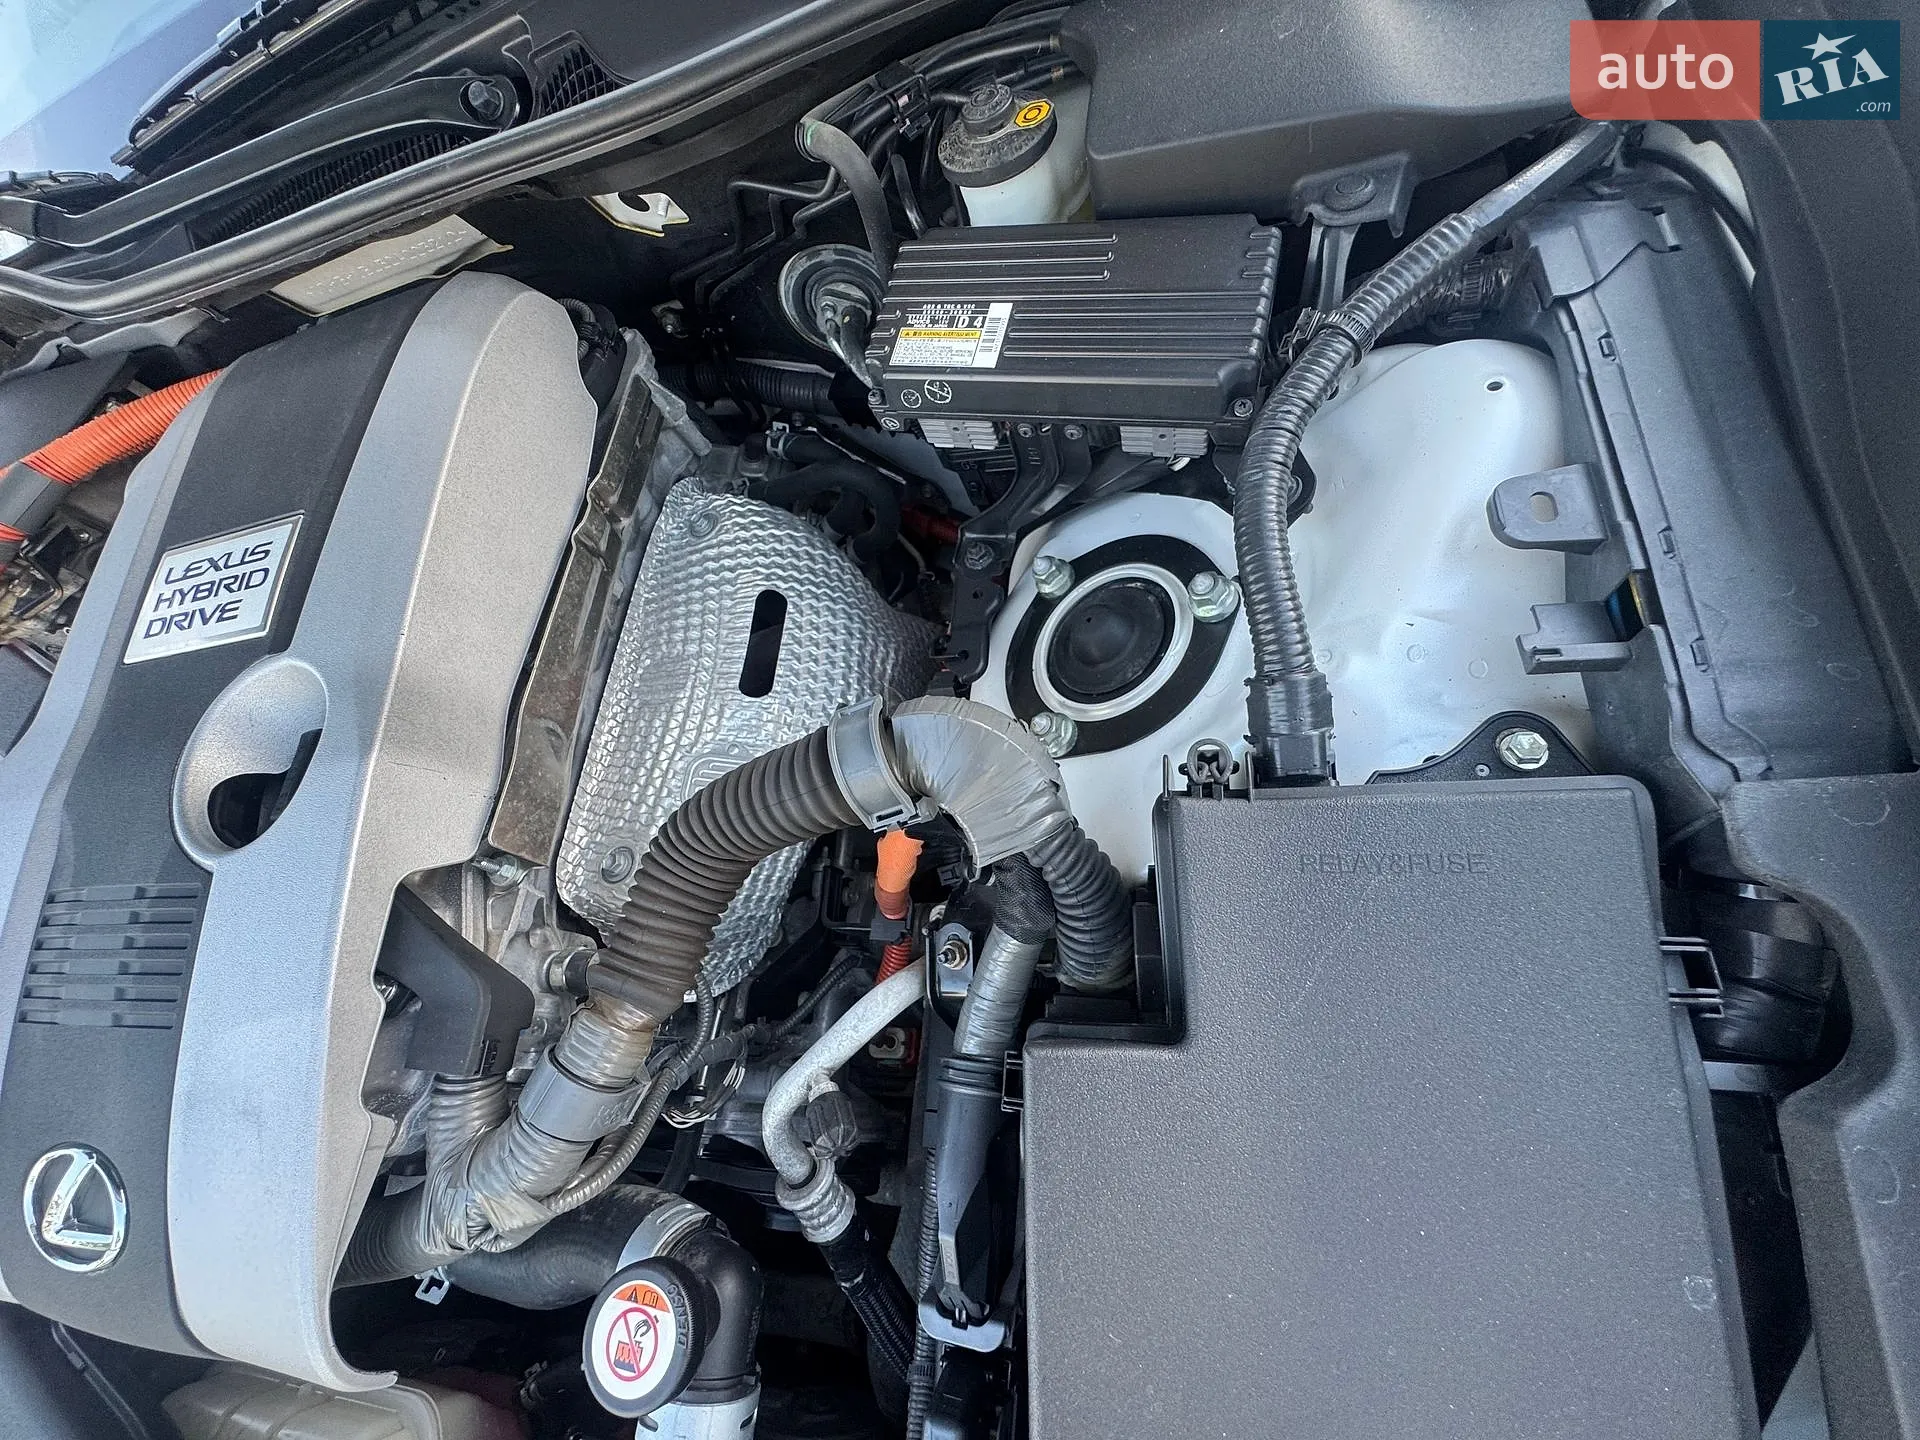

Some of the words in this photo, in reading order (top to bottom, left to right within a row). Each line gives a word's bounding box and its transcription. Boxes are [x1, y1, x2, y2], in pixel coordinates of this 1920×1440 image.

[973, 316, 984, 328] 4
[164, 540, 274, 586] LEXUS
[152, 566, 270, 613] HYBRID
[143, 598, 244, 640] DRIVE
[665, 1282, 687, 1349] DENSO
